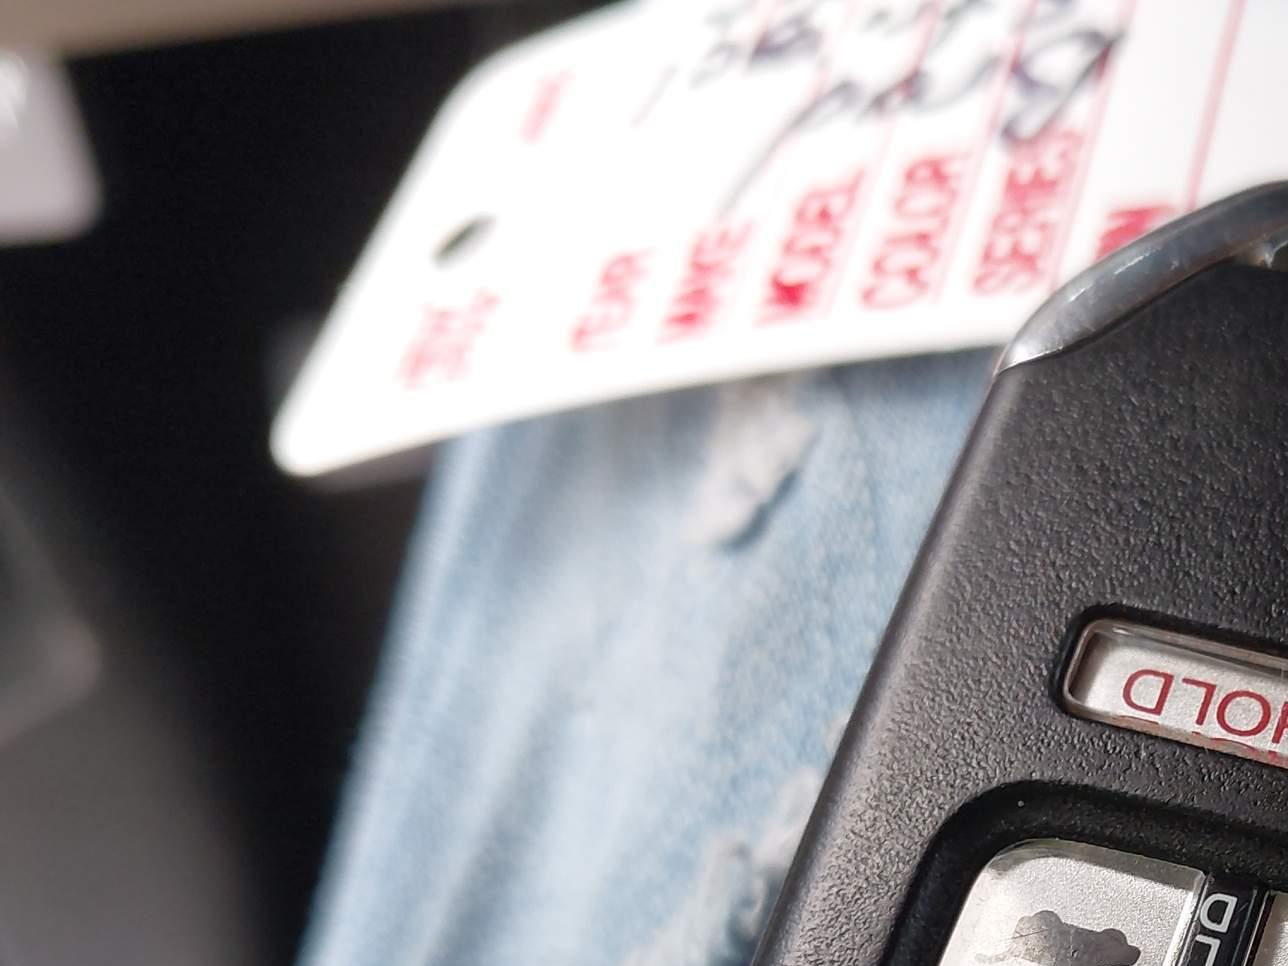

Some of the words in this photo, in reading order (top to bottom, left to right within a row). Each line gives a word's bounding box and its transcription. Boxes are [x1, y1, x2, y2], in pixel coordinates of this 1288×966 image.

[755, 168, 865, 327] MODEL
[859, 150, 968, 309] COLOR
[972, 128, 1083, 296] SERIES
